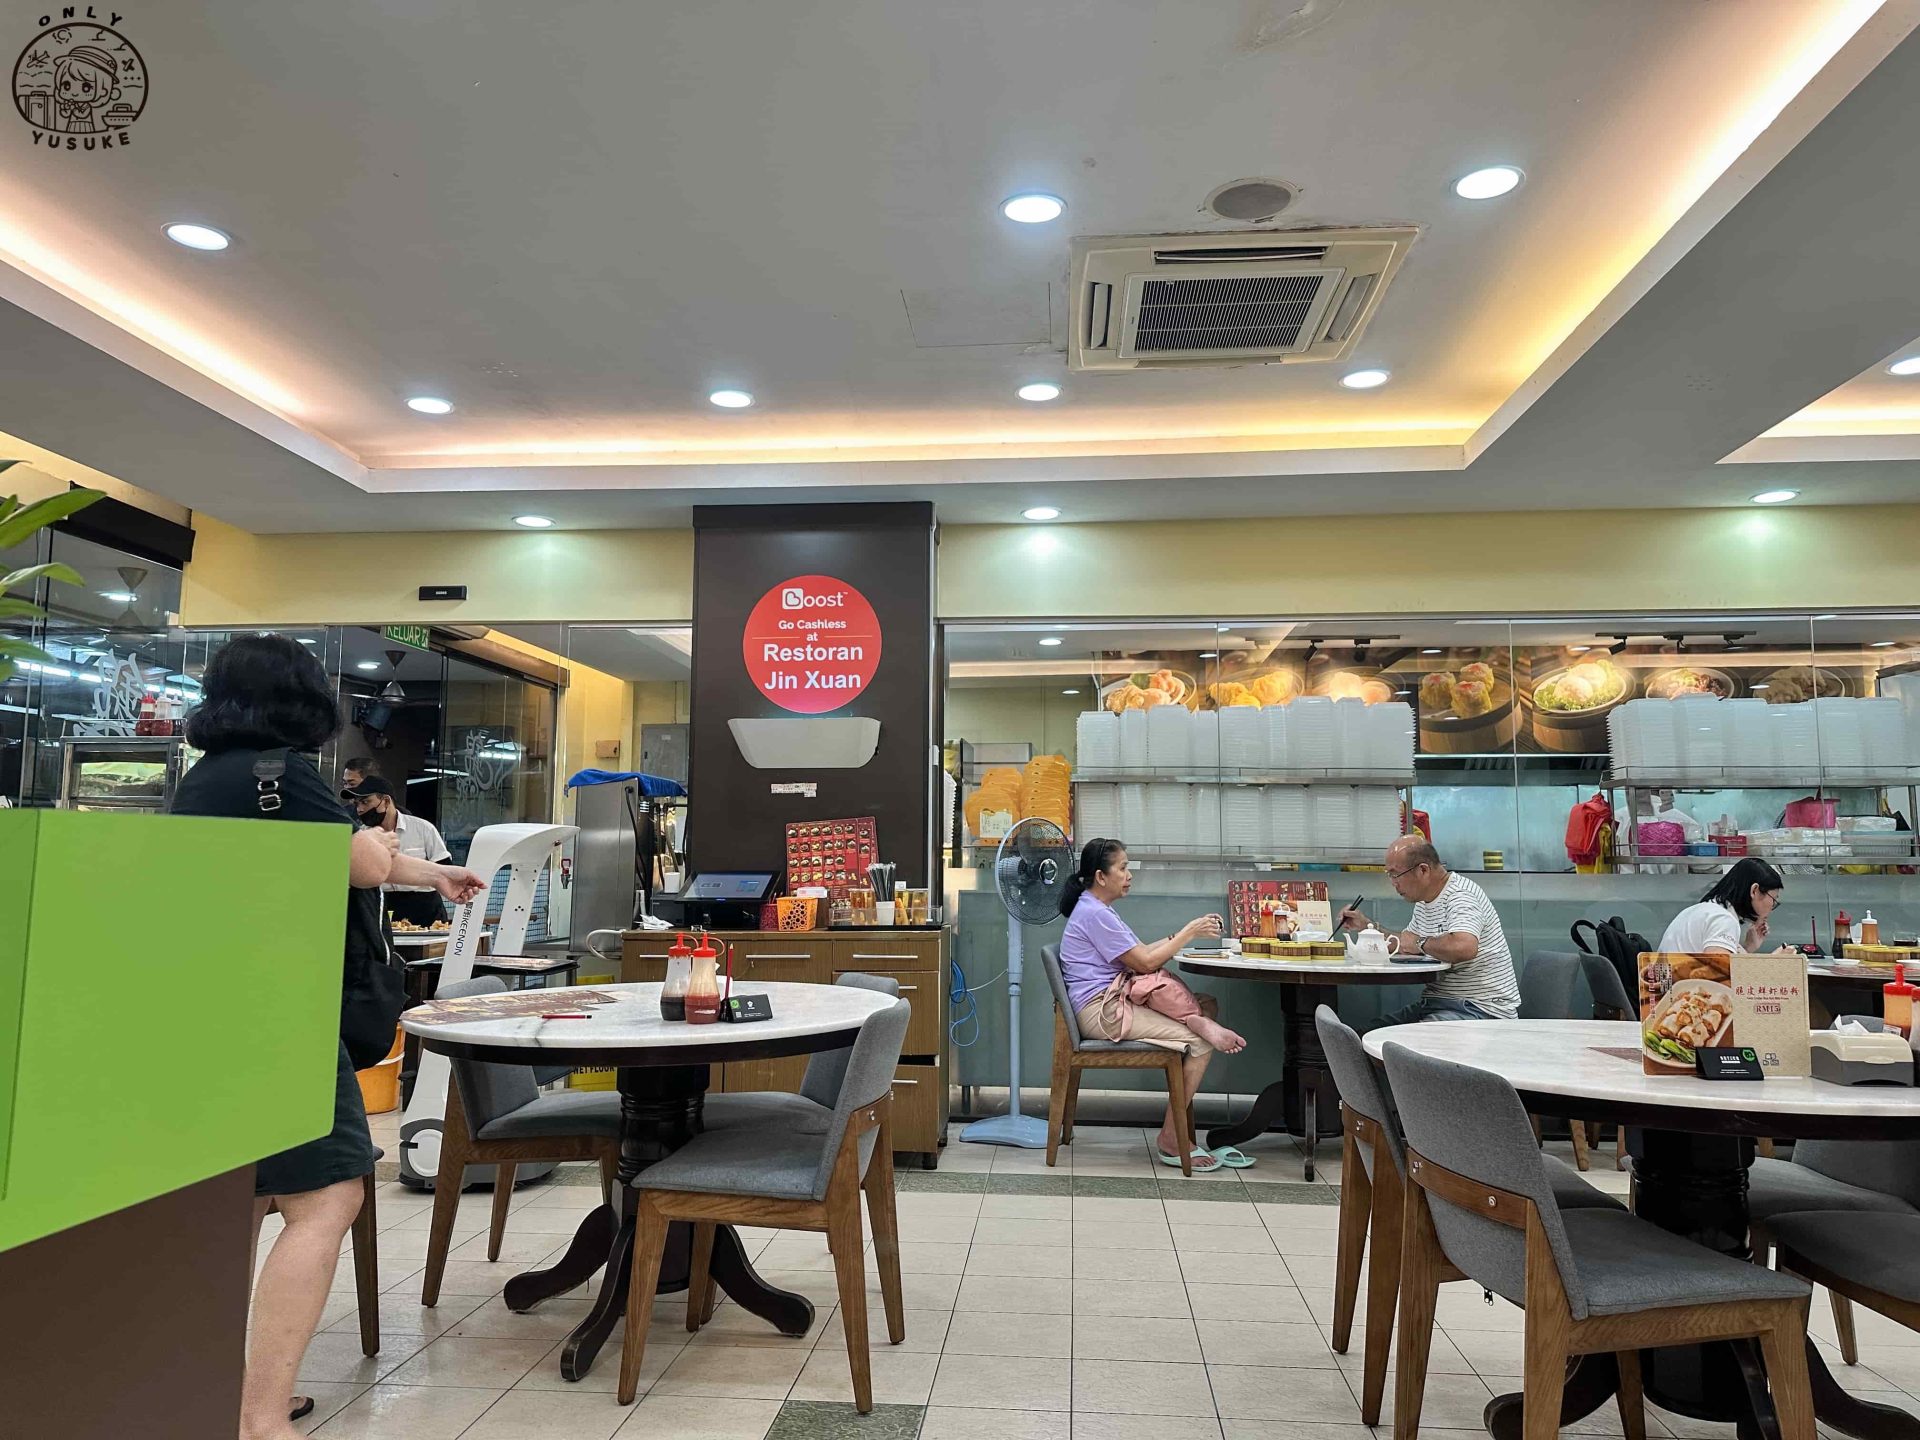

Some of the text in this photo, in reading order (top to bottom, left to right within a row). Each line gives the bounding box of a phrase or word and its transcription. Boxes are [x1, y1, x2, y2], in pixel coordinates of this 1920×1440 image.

[778, 618, 847, 630] Go Cashless
[387, 625, 421, 646] KELUAR
[806, 631, 818, 642] at
[763, 643, 863, 662] Restoran
[764, 670, 861, 690] Jin Xuan
